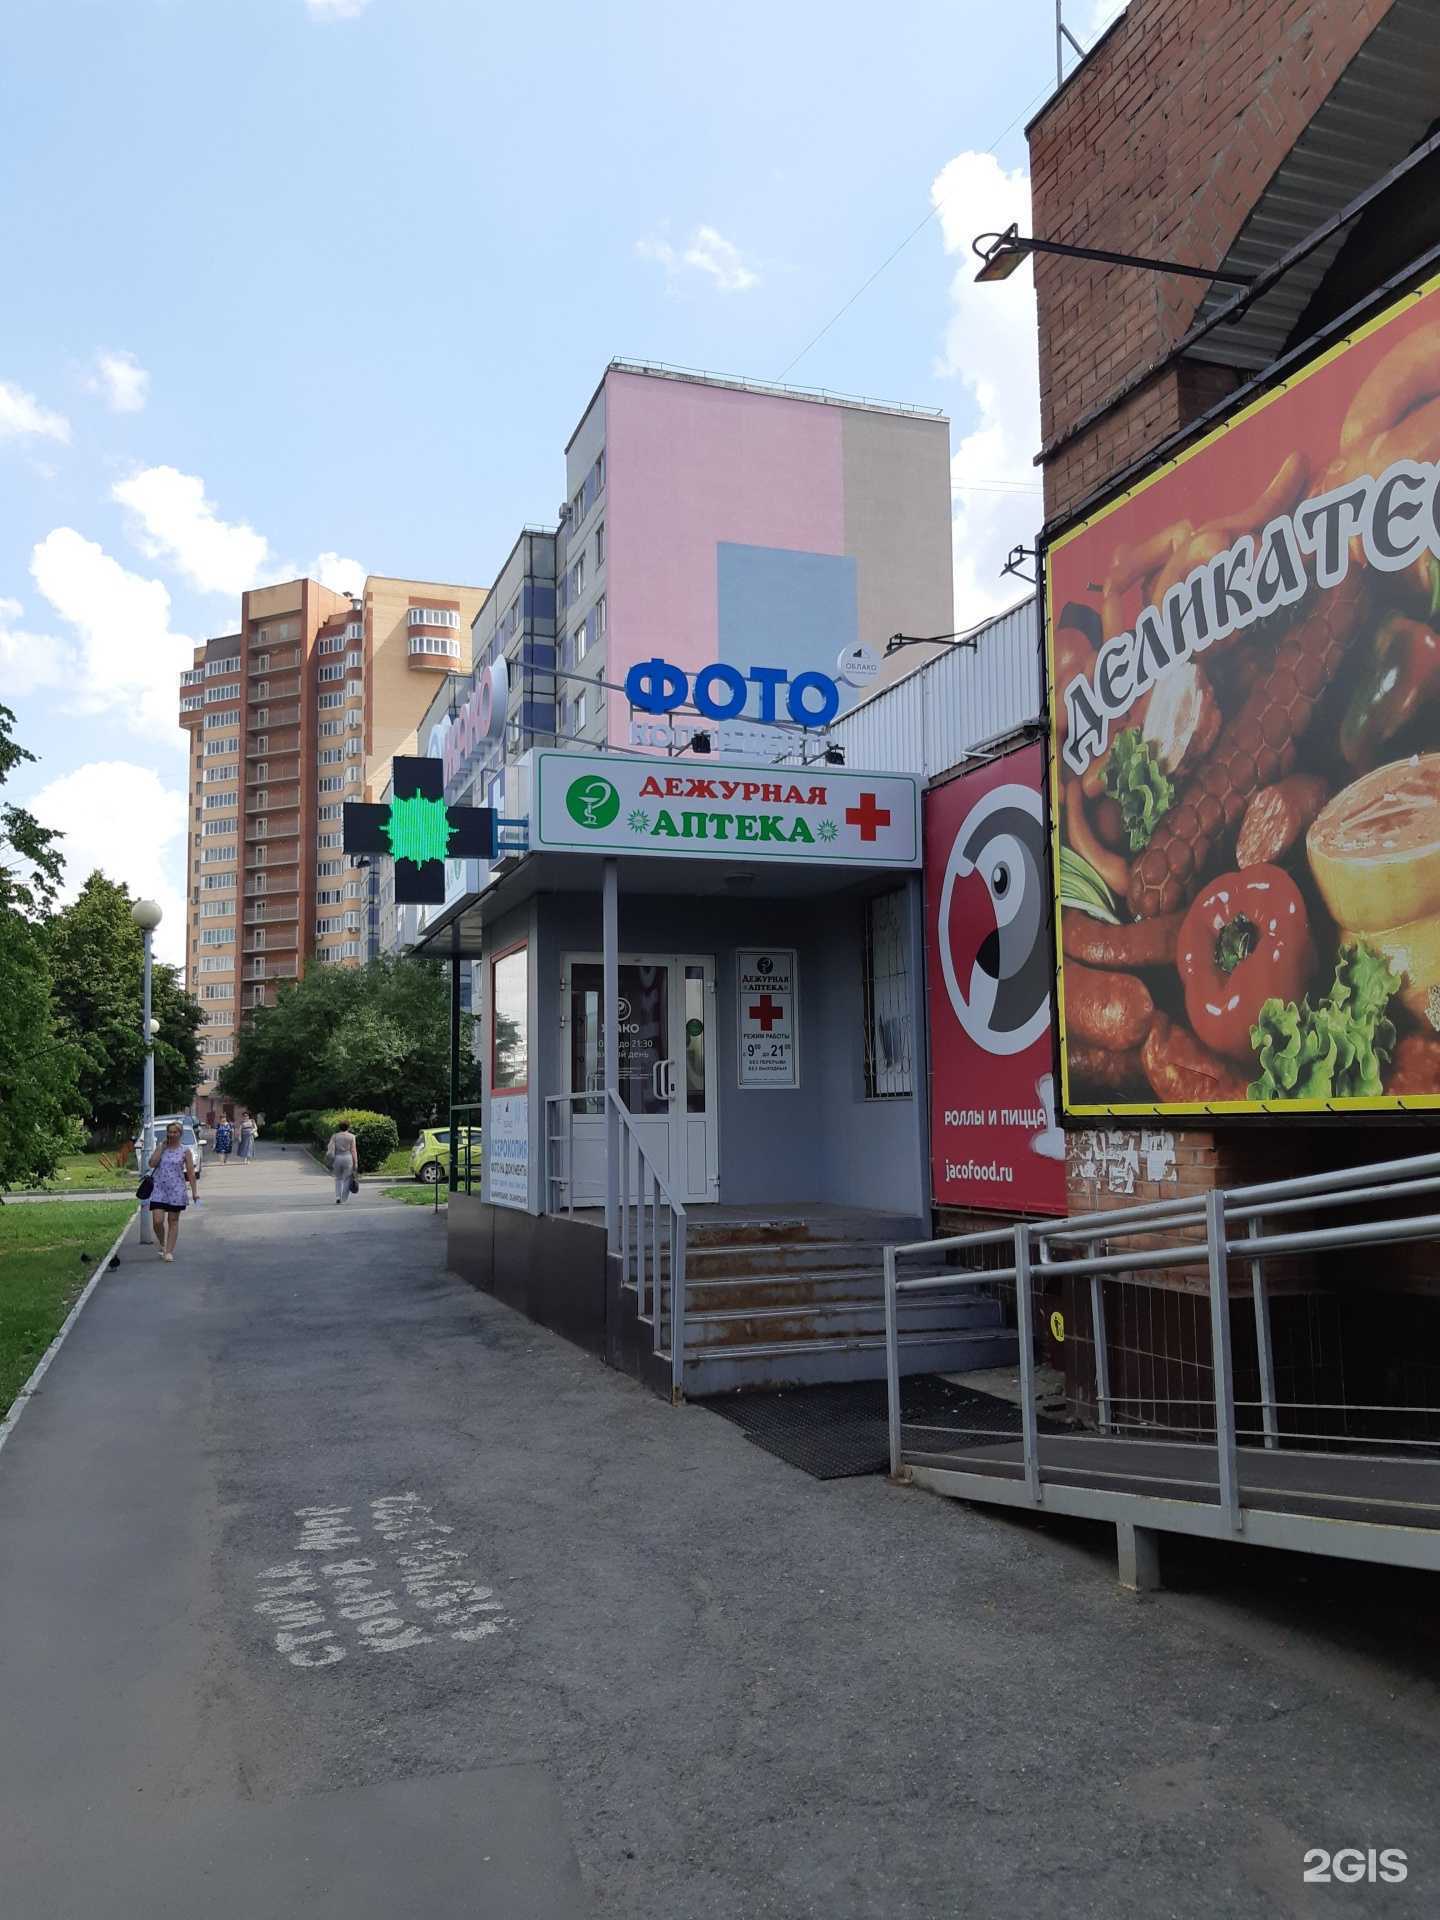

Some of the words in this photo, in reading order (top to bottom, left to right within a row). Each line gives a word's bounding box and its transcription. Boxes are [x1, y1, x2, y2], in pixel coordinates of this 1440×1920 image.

[845, 663, 877, 671] ОБЛАКО
[624, 658, 839, 728] ФОТО
[639, 776, 828, 805] ДЕЖУРНАЯ
[650, 809, 816, 844] АПТЕКА
[944, 1109, 984, 1126] РОЛЛЫ
[988, 1110, 997, 1126] И
[1001, 1108, 1047, 1128] ПИЦЦА
[944, 1159, 1013, 1182] jacofood.ru
